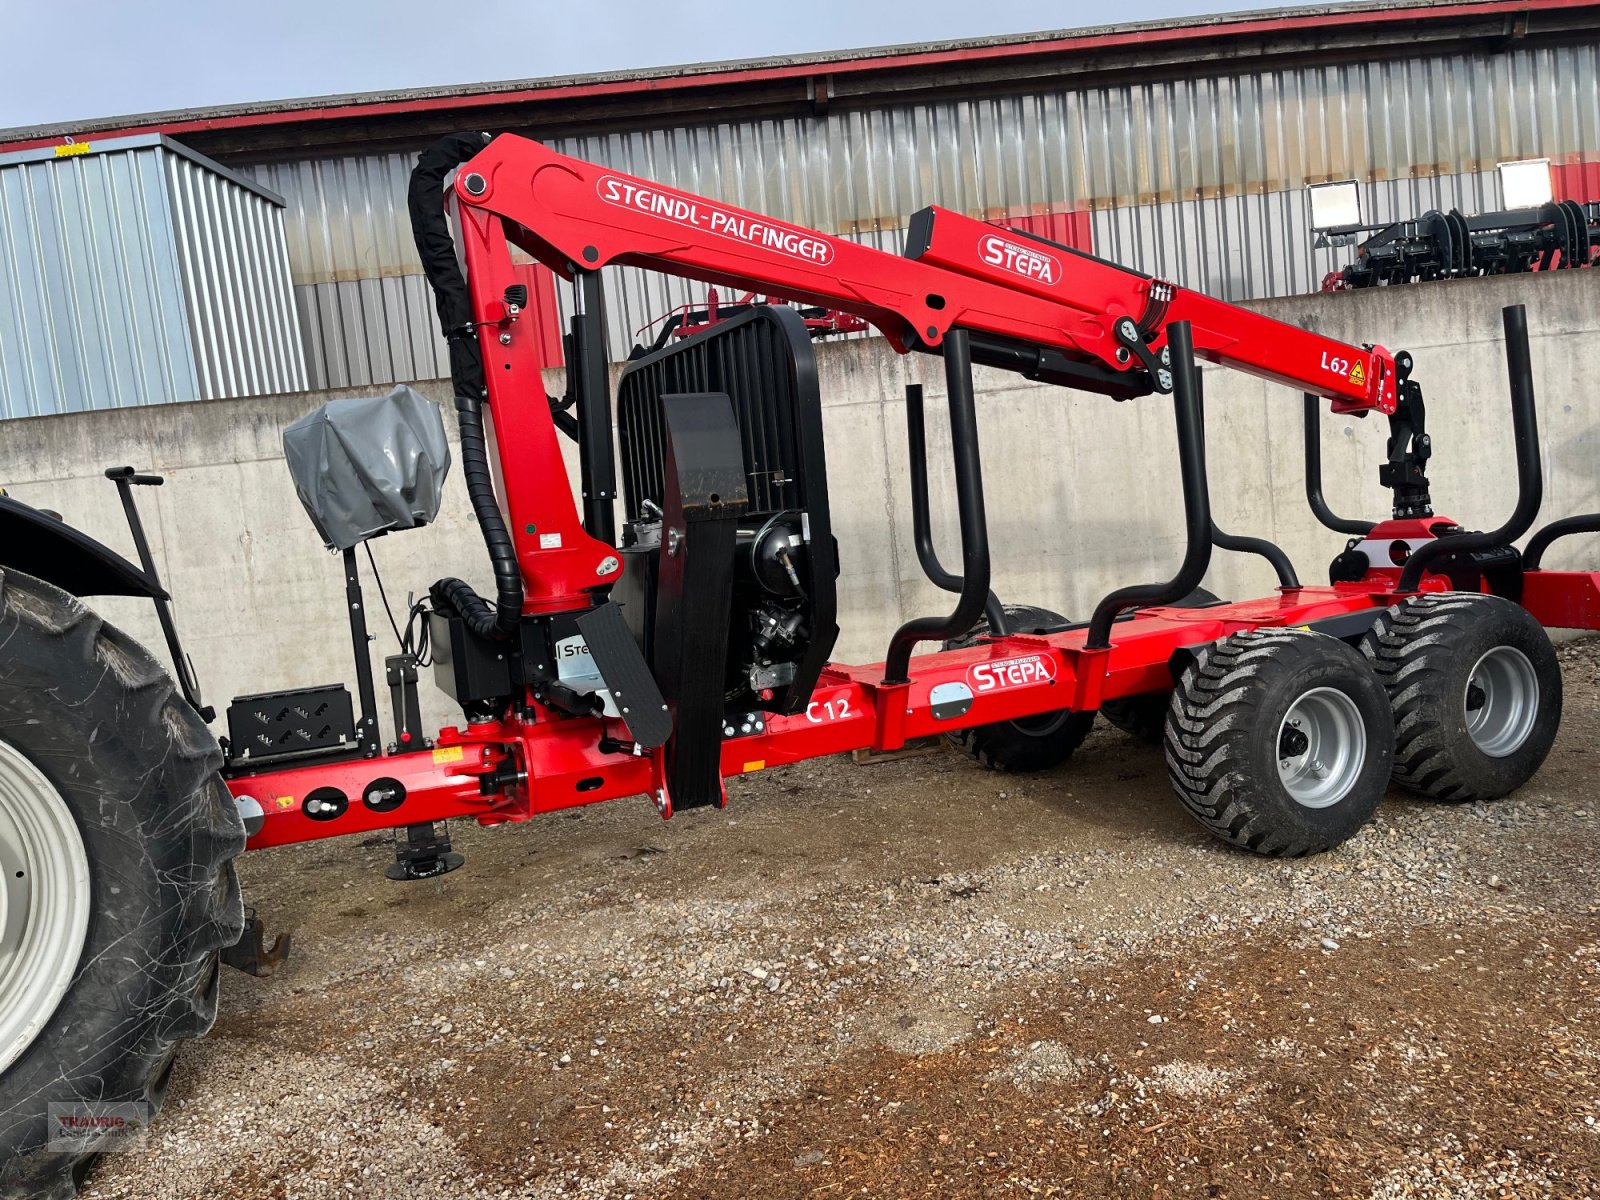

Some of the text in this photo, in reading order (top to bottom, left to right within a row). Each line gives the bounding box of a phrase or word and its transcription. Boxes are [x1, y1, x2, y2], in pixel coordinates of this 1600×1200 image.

[605, 180, 827, 261] STEINDL-PALFINGER
[985, 237, 1052, 283] STEPA
[1321, 351, 1348, 376] L62
[972, 660, 1051, 692] STEPA
